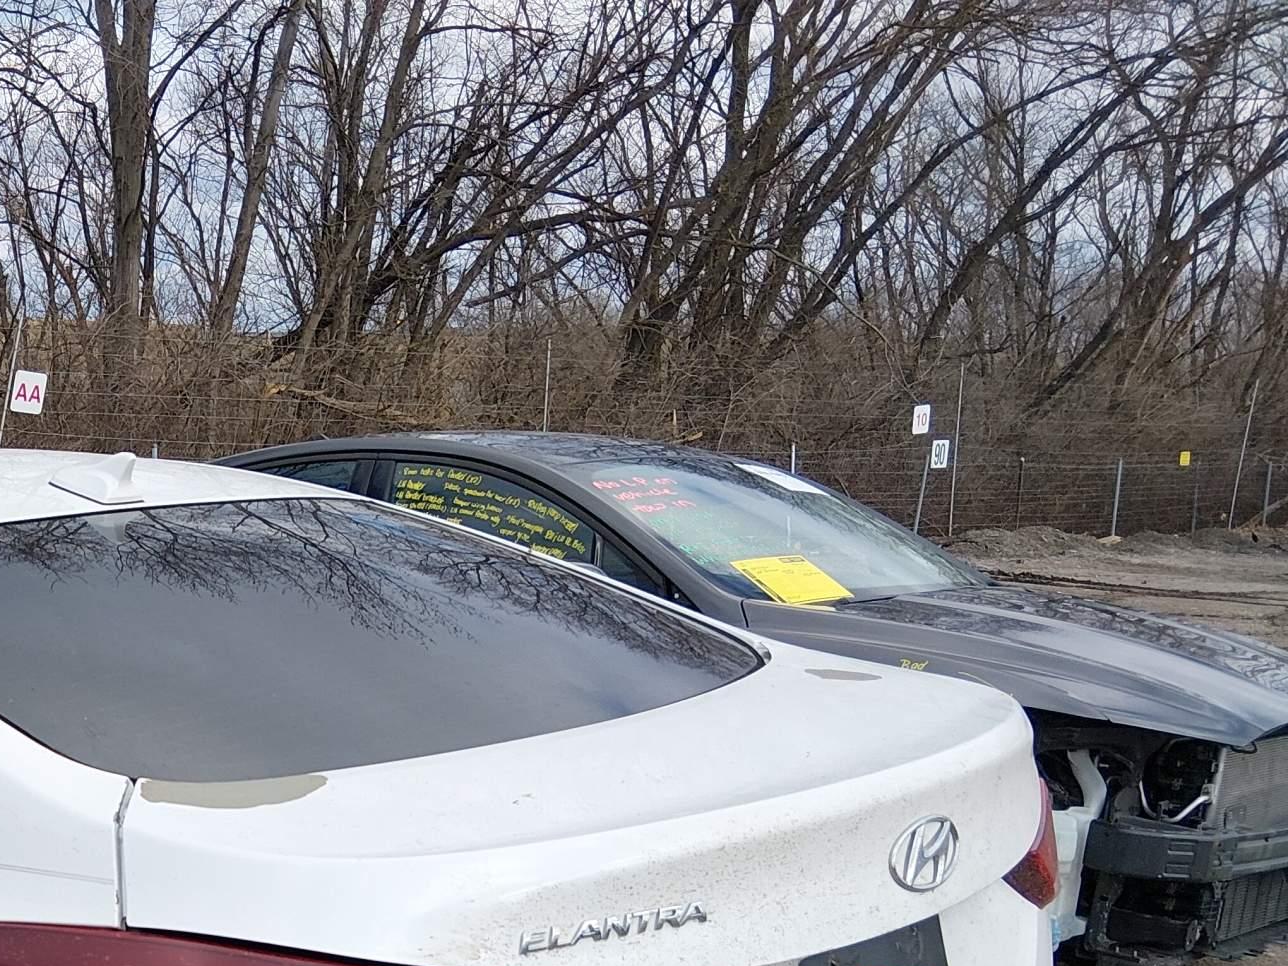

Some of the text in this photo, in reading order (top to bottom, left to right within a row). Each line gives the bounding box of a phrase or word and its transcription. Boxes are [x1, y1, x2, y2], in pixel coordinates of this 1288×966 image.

[14, 383, 41, 403] AA
[916, 412, 928, 428] 10
[933, 443, 946, 466] 90
[519, 901, 707, 956] ELANTRA
